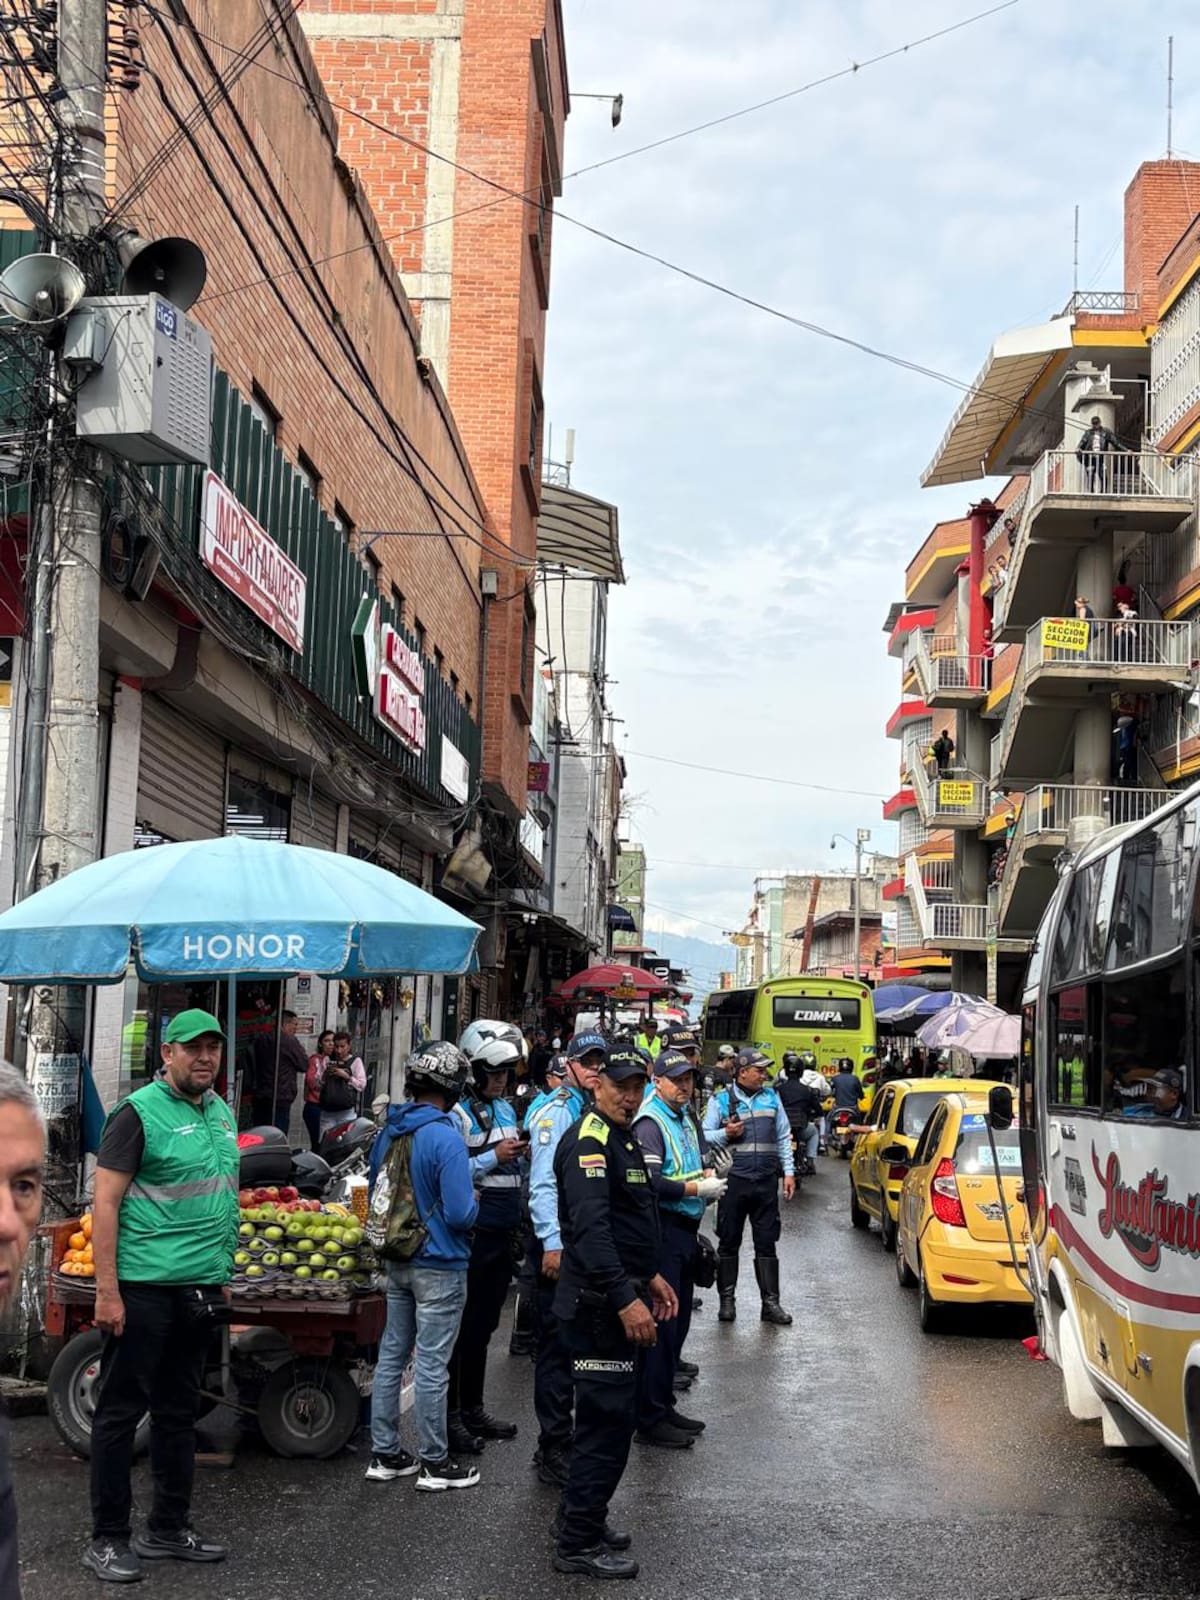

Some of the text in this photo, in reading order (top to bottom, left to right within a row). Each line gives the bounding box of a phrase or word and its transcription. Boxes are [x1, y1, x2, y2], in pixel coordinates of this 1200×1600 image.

[217, 491, 301, 623] IMPORTADORES
[1045, 634, 1084, 645] CALZADO
[184, 934, 305, 960] HONOR
[793, 1009, 842, 1022] COMPA
[1091, 1138, 1200, 1272] Lusitani
